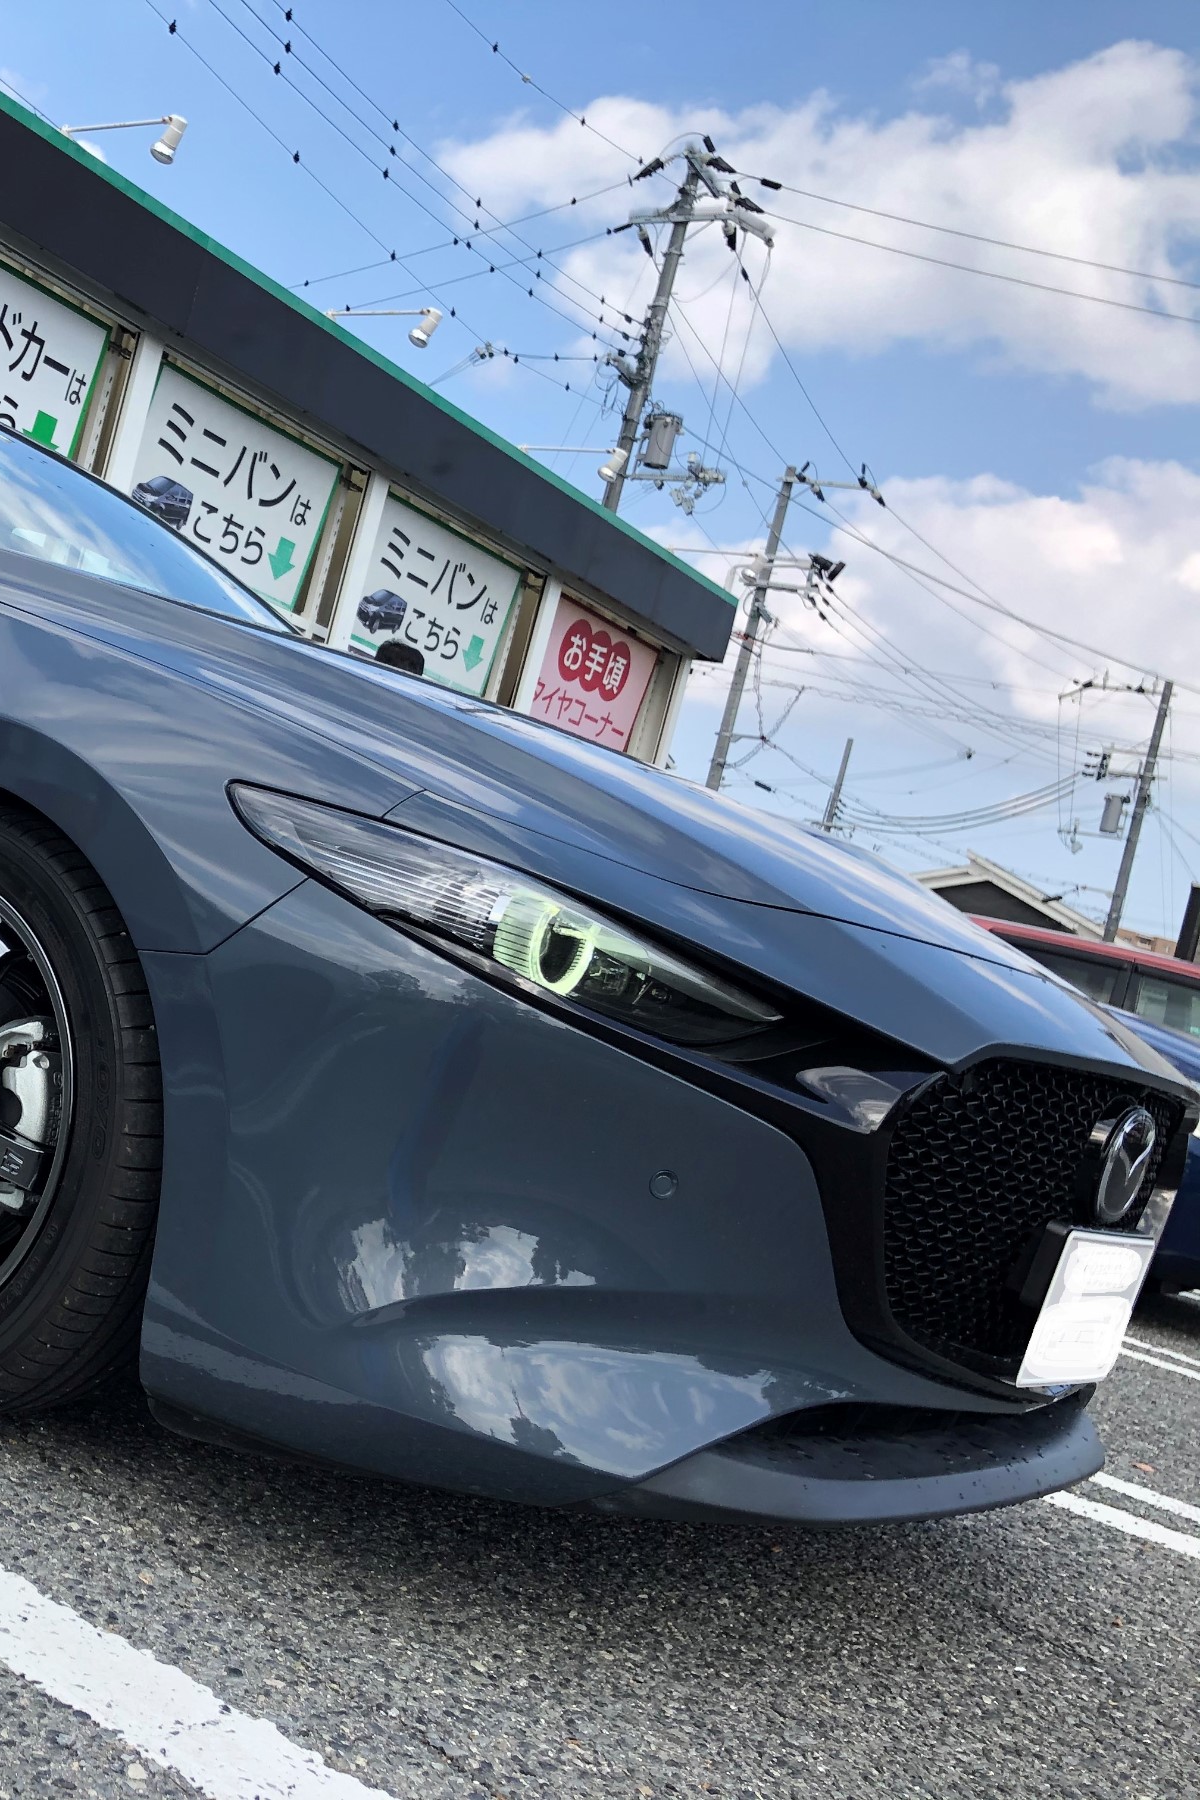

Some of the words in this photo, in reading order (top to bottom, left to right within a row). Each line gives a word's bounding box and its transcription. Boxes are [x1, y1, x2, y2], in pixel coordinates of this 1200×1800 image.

[157, 402, 312, 527] ミニバンは
[192, 500, 266, 566] こちら
[380, 526, 499, 625] ミニバンは
[403, 607, 462, 660] こちら
[563, 633, 628, 695] お手頃
